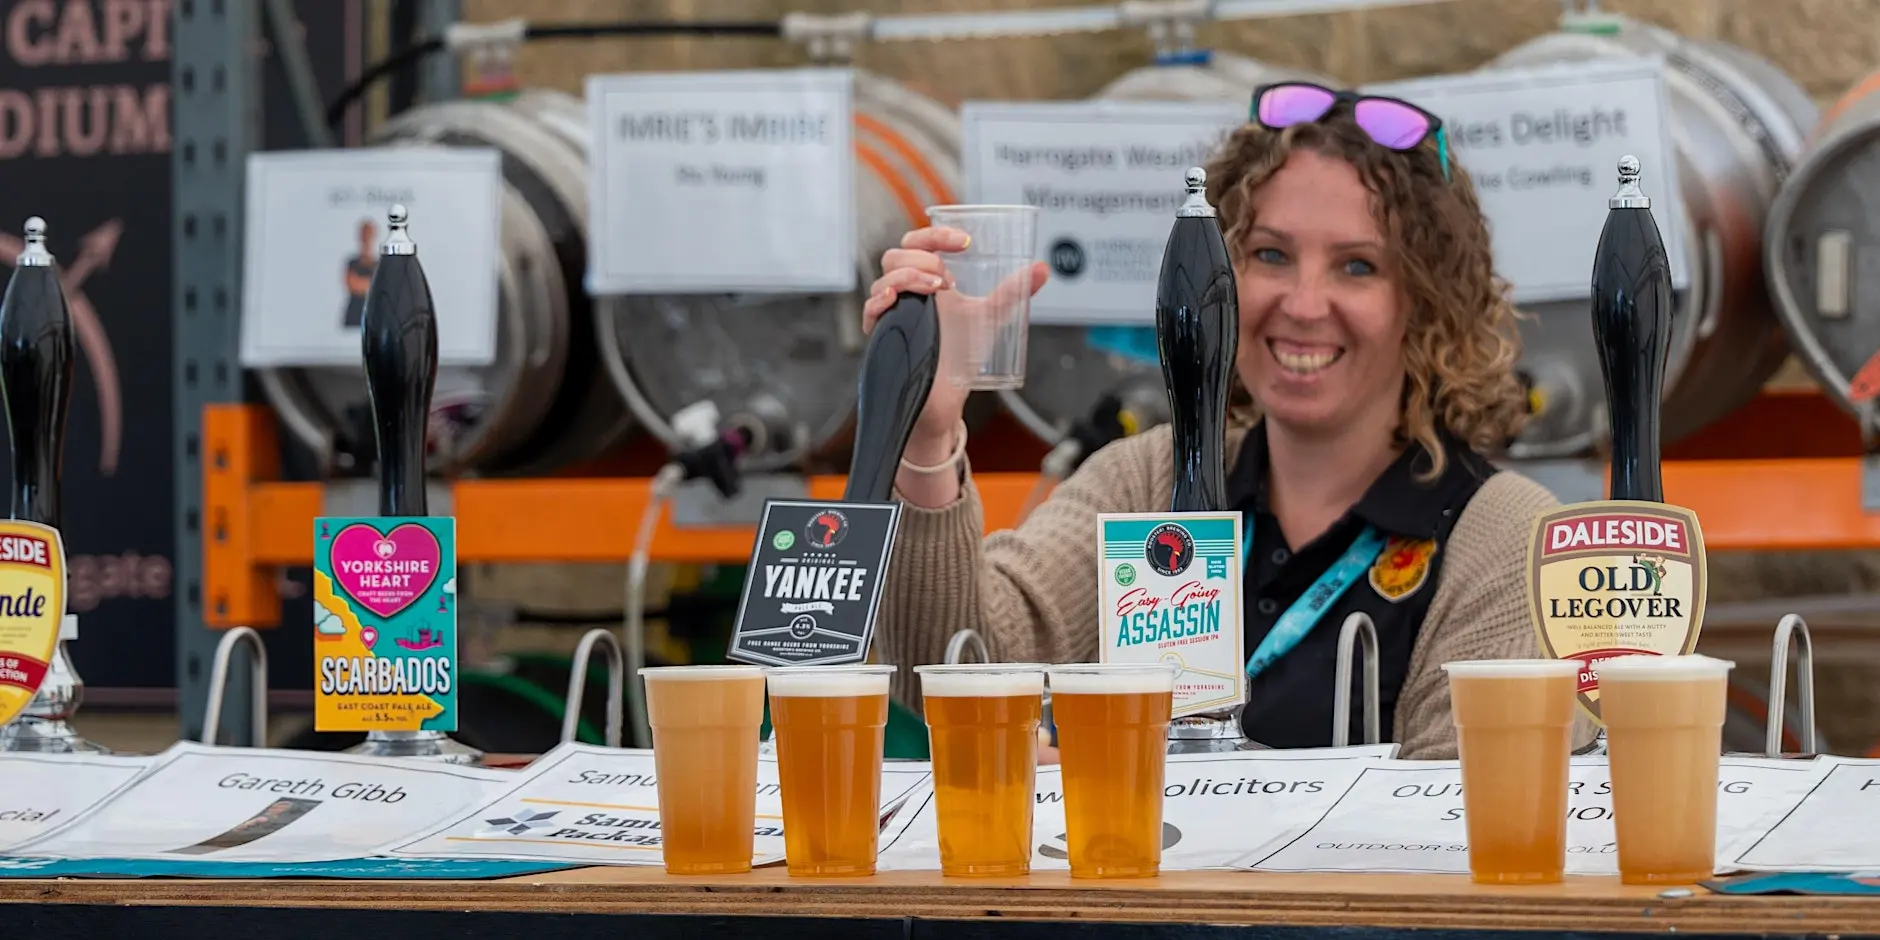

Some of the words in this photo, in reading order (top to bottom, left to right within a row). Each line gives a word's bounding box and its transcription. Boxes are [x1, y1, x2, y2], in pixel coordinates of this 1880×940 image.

[1510, 107, 1628, 148] Delight
[994, 142, 1115, 171] Harrogate
[1551, 519, 1681, 550] DALESIDE
[0, 536, 47, 565] SIDE
[341, 560, 430, 573] YORKSHIRE
[360, 574, 411, 588] HEART
[1578, 566, 1653, 592] OLD
[764, 565, 867, 601] YANKEE
[1550, 598, 1683, 619] LEGOVER
[1117, 600, 1220, 647] ASSASSIN
[1157, 641, 1176, 649] GLUTEN
[1189, 636, 1209, 644] SESSION
[321, 656, 451, 695] SCARBADOS
[218, 772, 325, 796] Gareth
[331, 782, 407, 804] Gibb
[1316, 842, 1442, 851] OUTDOOR
